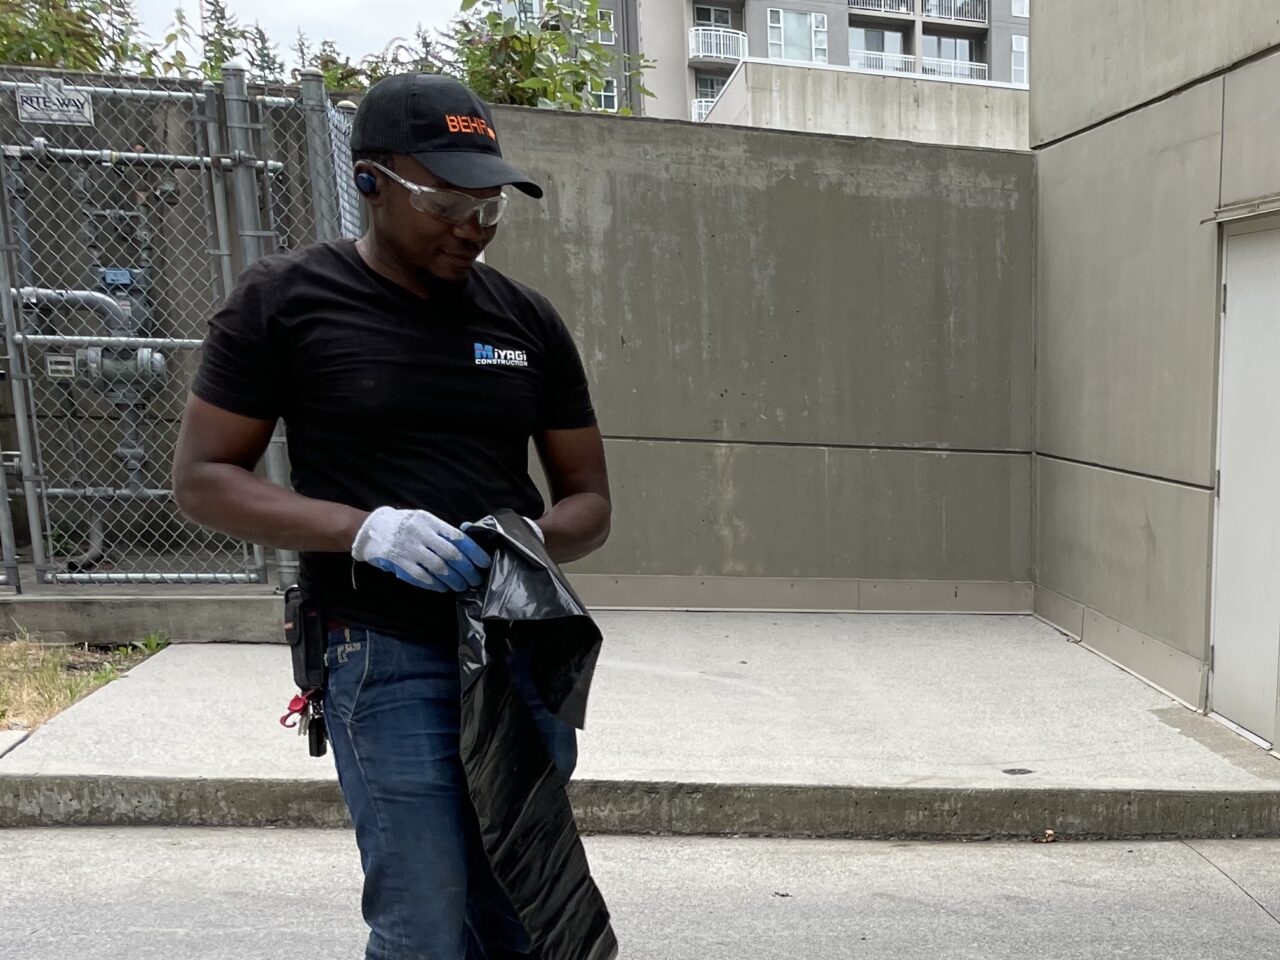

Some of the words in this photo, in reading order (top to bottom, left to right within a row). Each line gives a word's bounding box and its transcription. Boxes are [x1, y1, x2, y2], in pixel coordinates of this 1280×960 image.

[20, 95, 85, 110] RITE-WAY
[445, 115, 486, 134] BEHR
[475, 358, 528, 367] CONSTRUCTION
